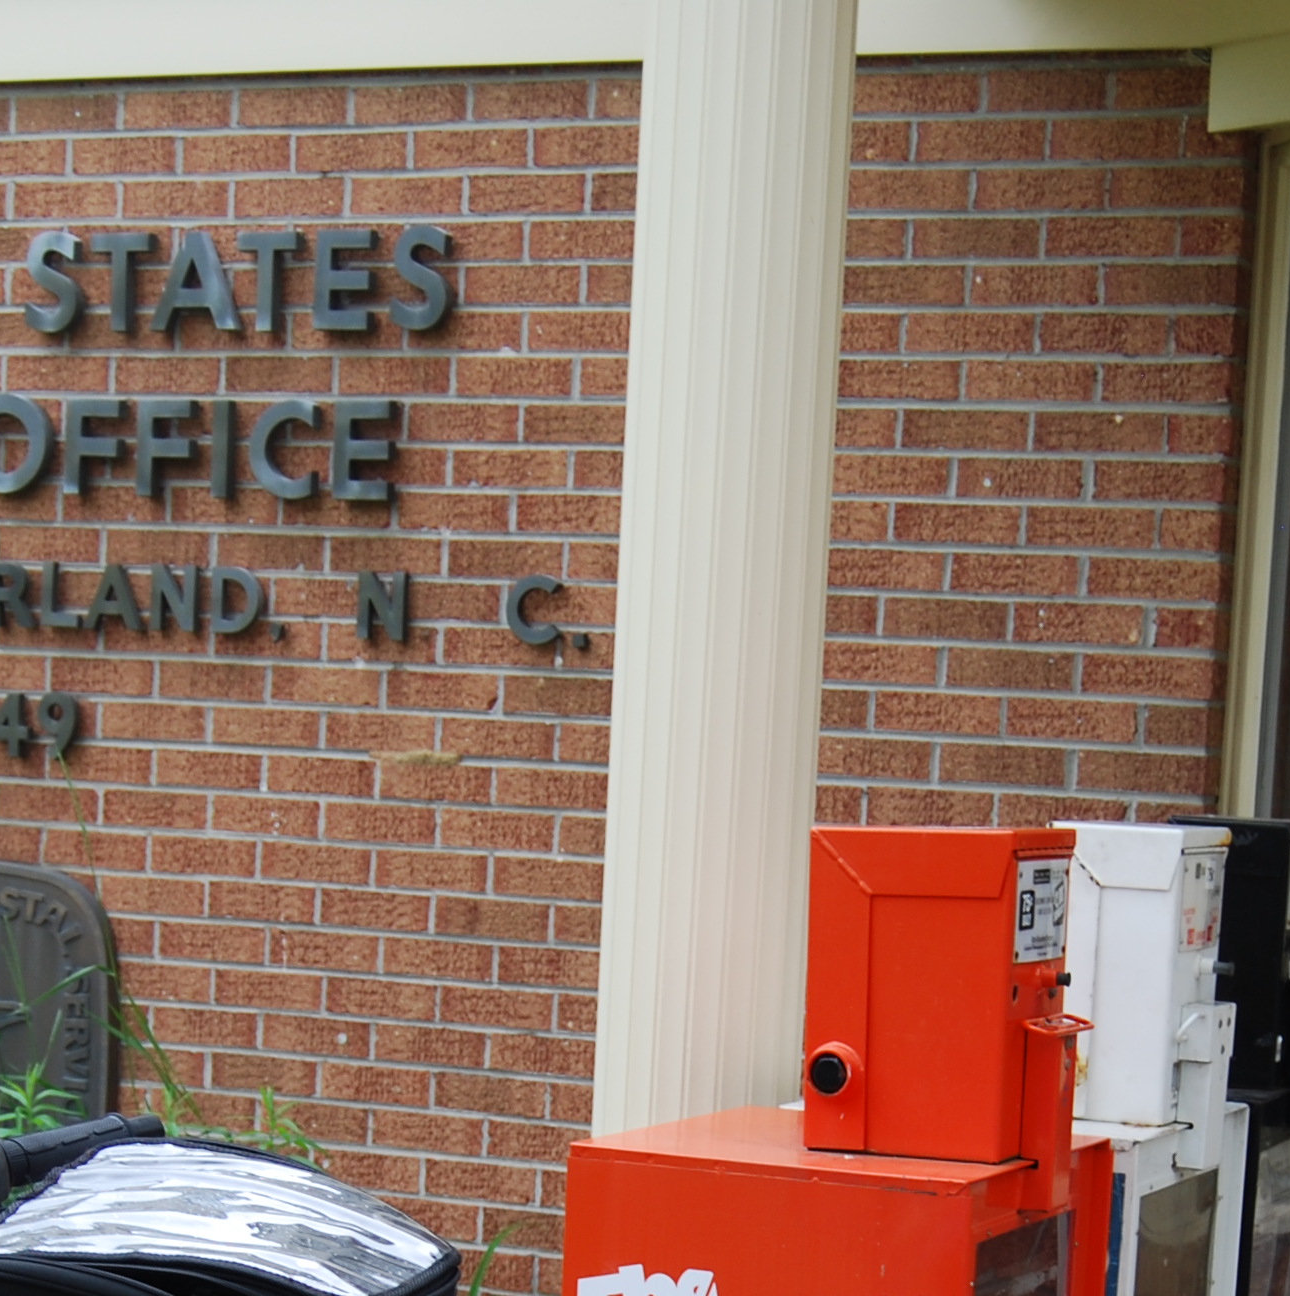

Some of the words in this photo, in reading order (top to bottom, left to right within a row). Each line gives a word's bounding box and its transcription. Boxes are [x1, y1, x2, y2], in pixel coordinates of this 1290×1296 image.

[24, 225, 453, 334] STATES
[356, 571, 409, 642] N
[506, 574, 590, 651] C.
